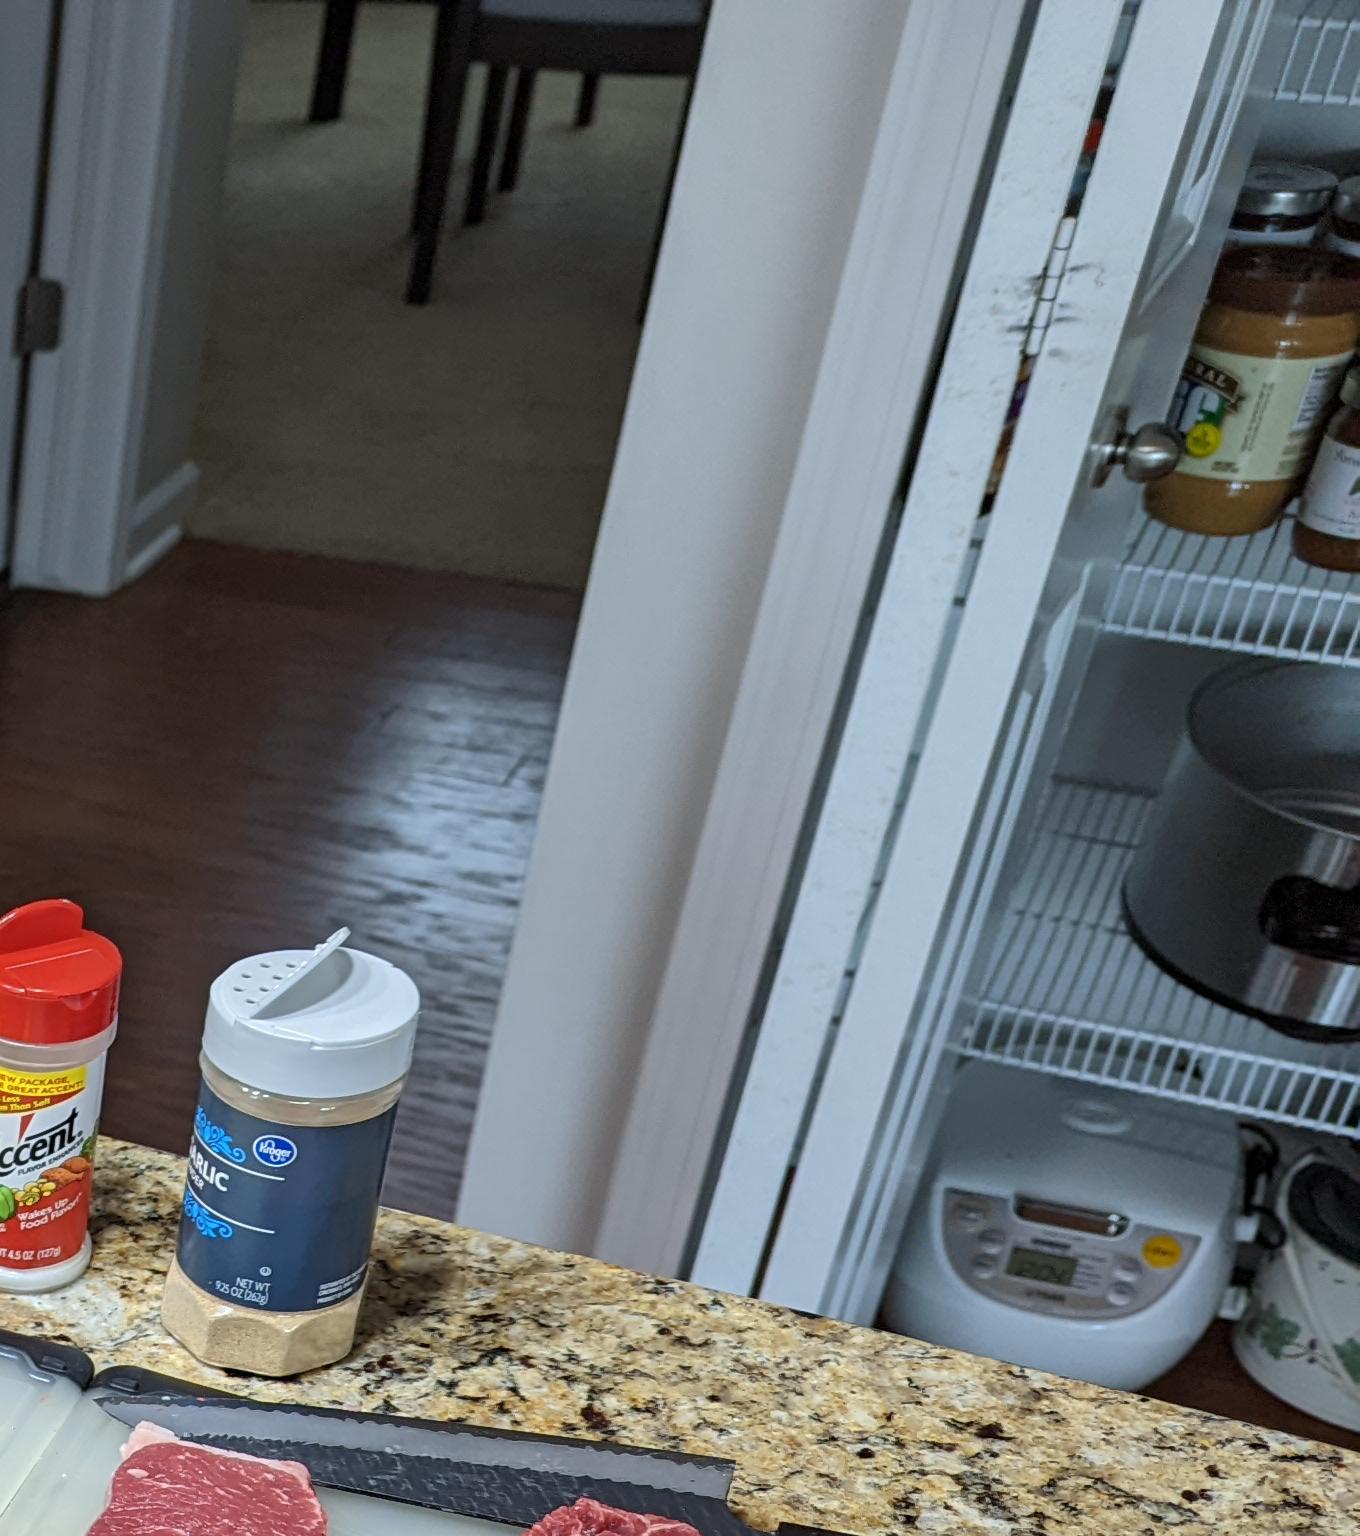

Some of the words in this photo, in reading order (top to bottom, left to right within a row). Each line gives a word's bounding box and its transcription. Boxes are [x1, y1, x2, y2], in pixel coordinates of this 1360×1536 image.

[7, 1084, 40, 1094] GREAT
[2, 1095, 20, 1103] Less
[10, 1103, 31, 1111] Than
[258, 1139, 292, 1162] Kroger
[17, 1159, 47, 1176] FLAVOR
[190, 1139, 230, 1192] ARLIC
[17, 1205, 53, 1221] Wakes
[54, 1198, 69, 1210] Up
[20, 1216, 48, 1231] Food
[7, 1249, 21, 1260] 4.5
[22, 1250, 34, 1260] OZ
[36, 1245, 61, 1260] (127g)
[236, 1277, 253, 1289] NET
[255, 1281, 271, 1292] WT
[231, 1286, 243, 1299] OZ
[244, 1289, 269, 1306] (262g)
